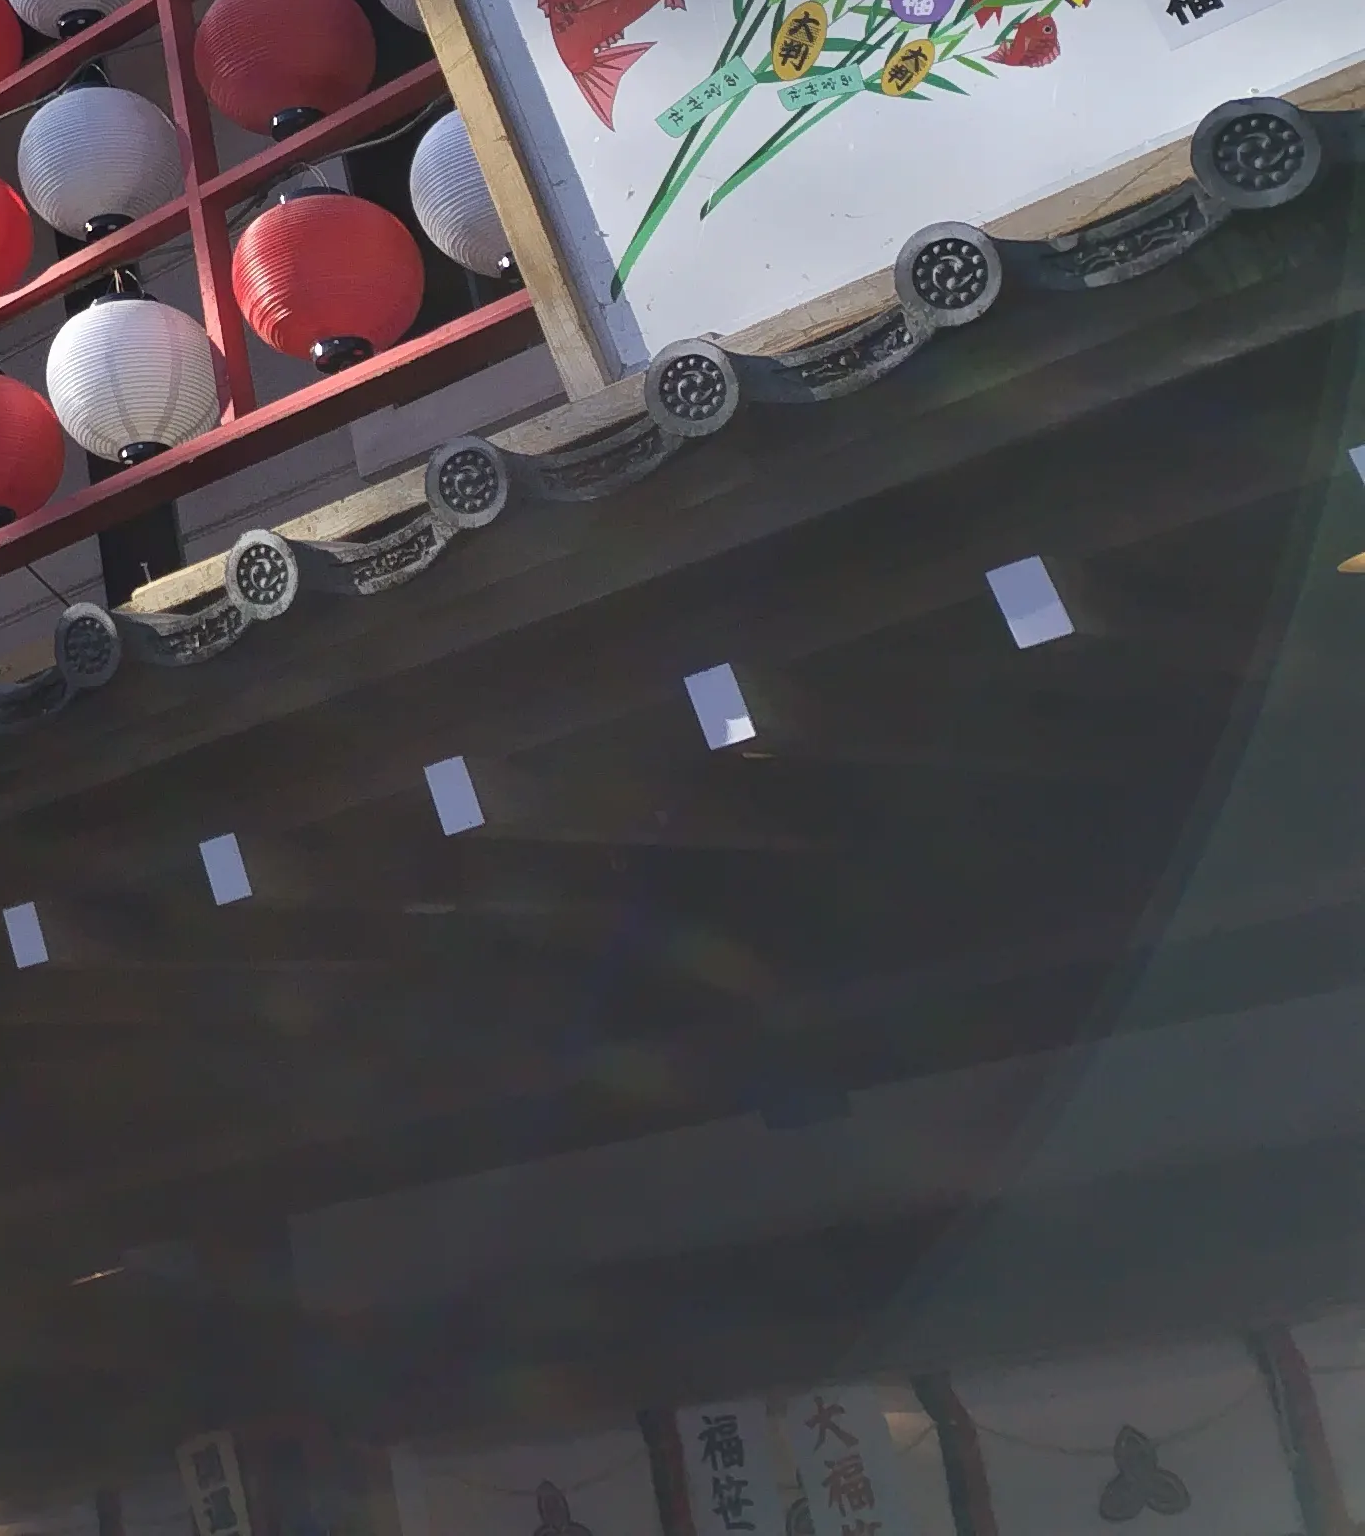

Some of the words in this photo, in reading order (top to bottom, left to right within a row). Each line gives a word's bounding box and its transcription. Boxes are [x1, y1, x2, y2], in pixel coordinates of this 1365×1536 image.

[778, 11, 820, 72] 大判
[887, 46, 929, 92] 大判
[667, 72, 740, 126] 西宮神社
[697, 1414, 757, 1531] 福笹
